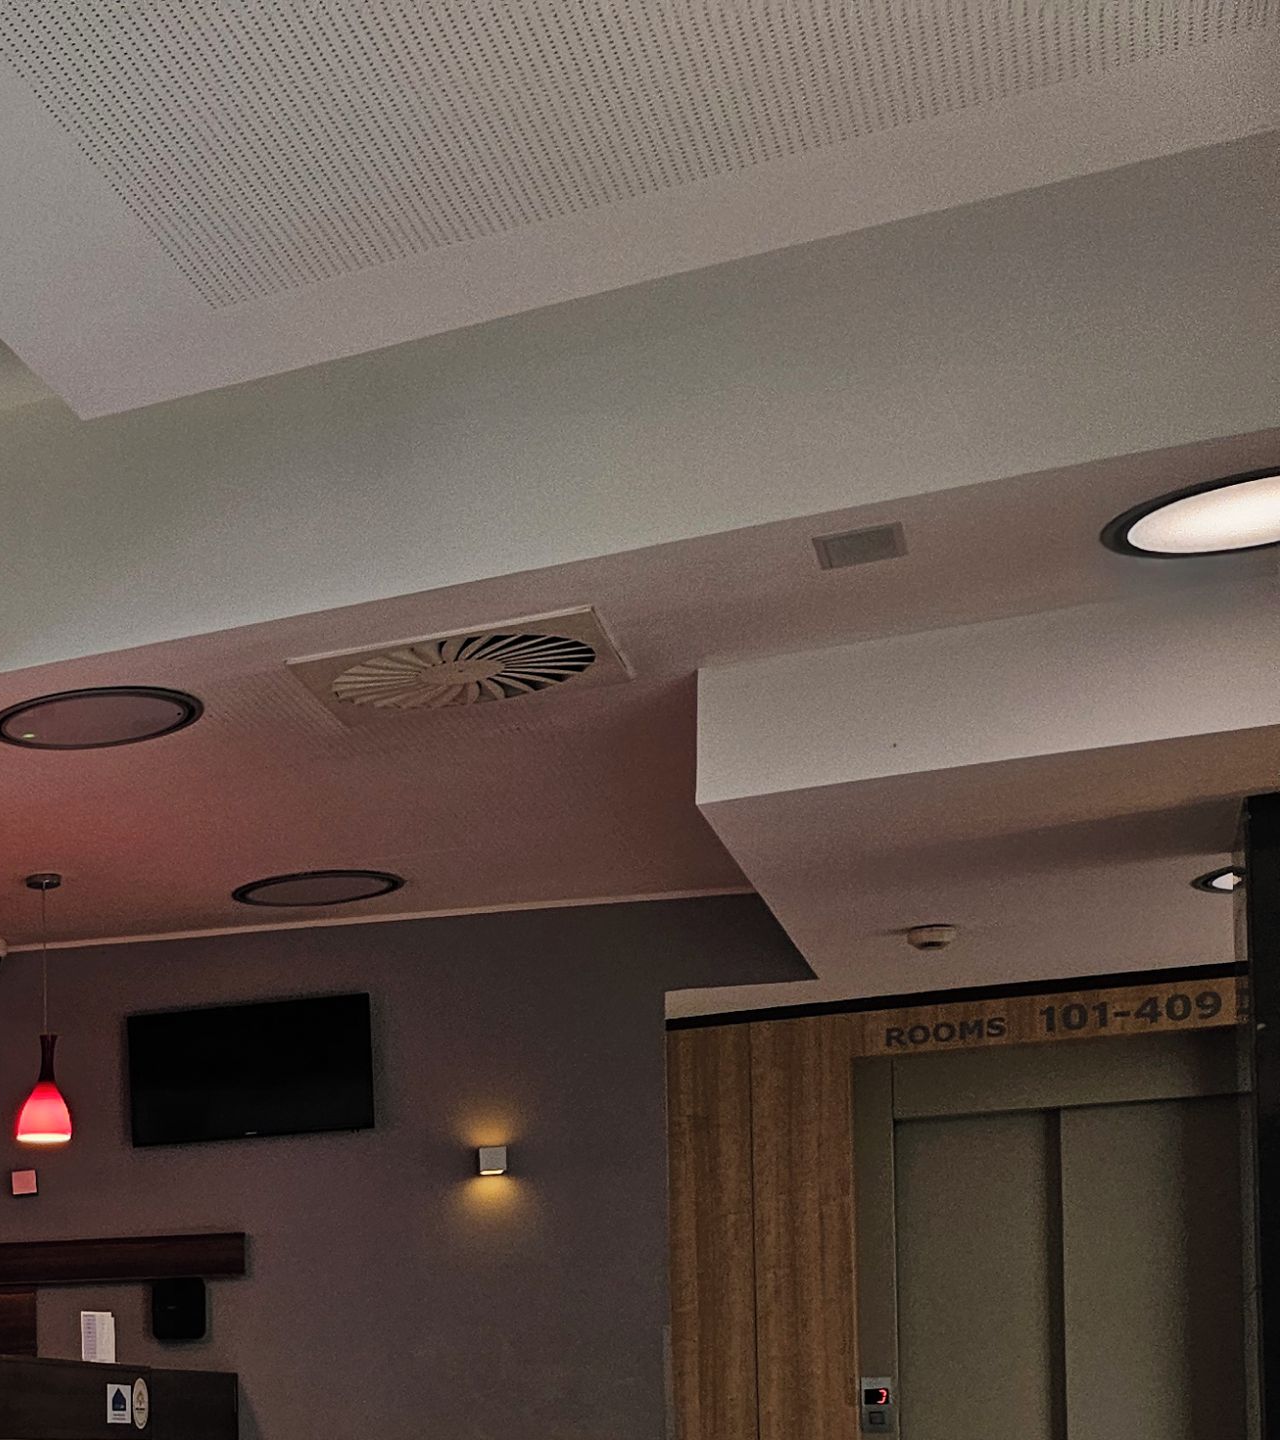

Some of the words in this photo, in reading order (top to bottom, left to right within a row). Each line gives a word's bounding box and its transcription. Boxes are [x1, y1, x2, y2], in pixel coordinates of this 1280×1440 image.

[884, 1016, 1007, 1048] ROOMS
[1040, 990, 1223, 1033] 101-409
[876, 1388, 888, 1405] 3
